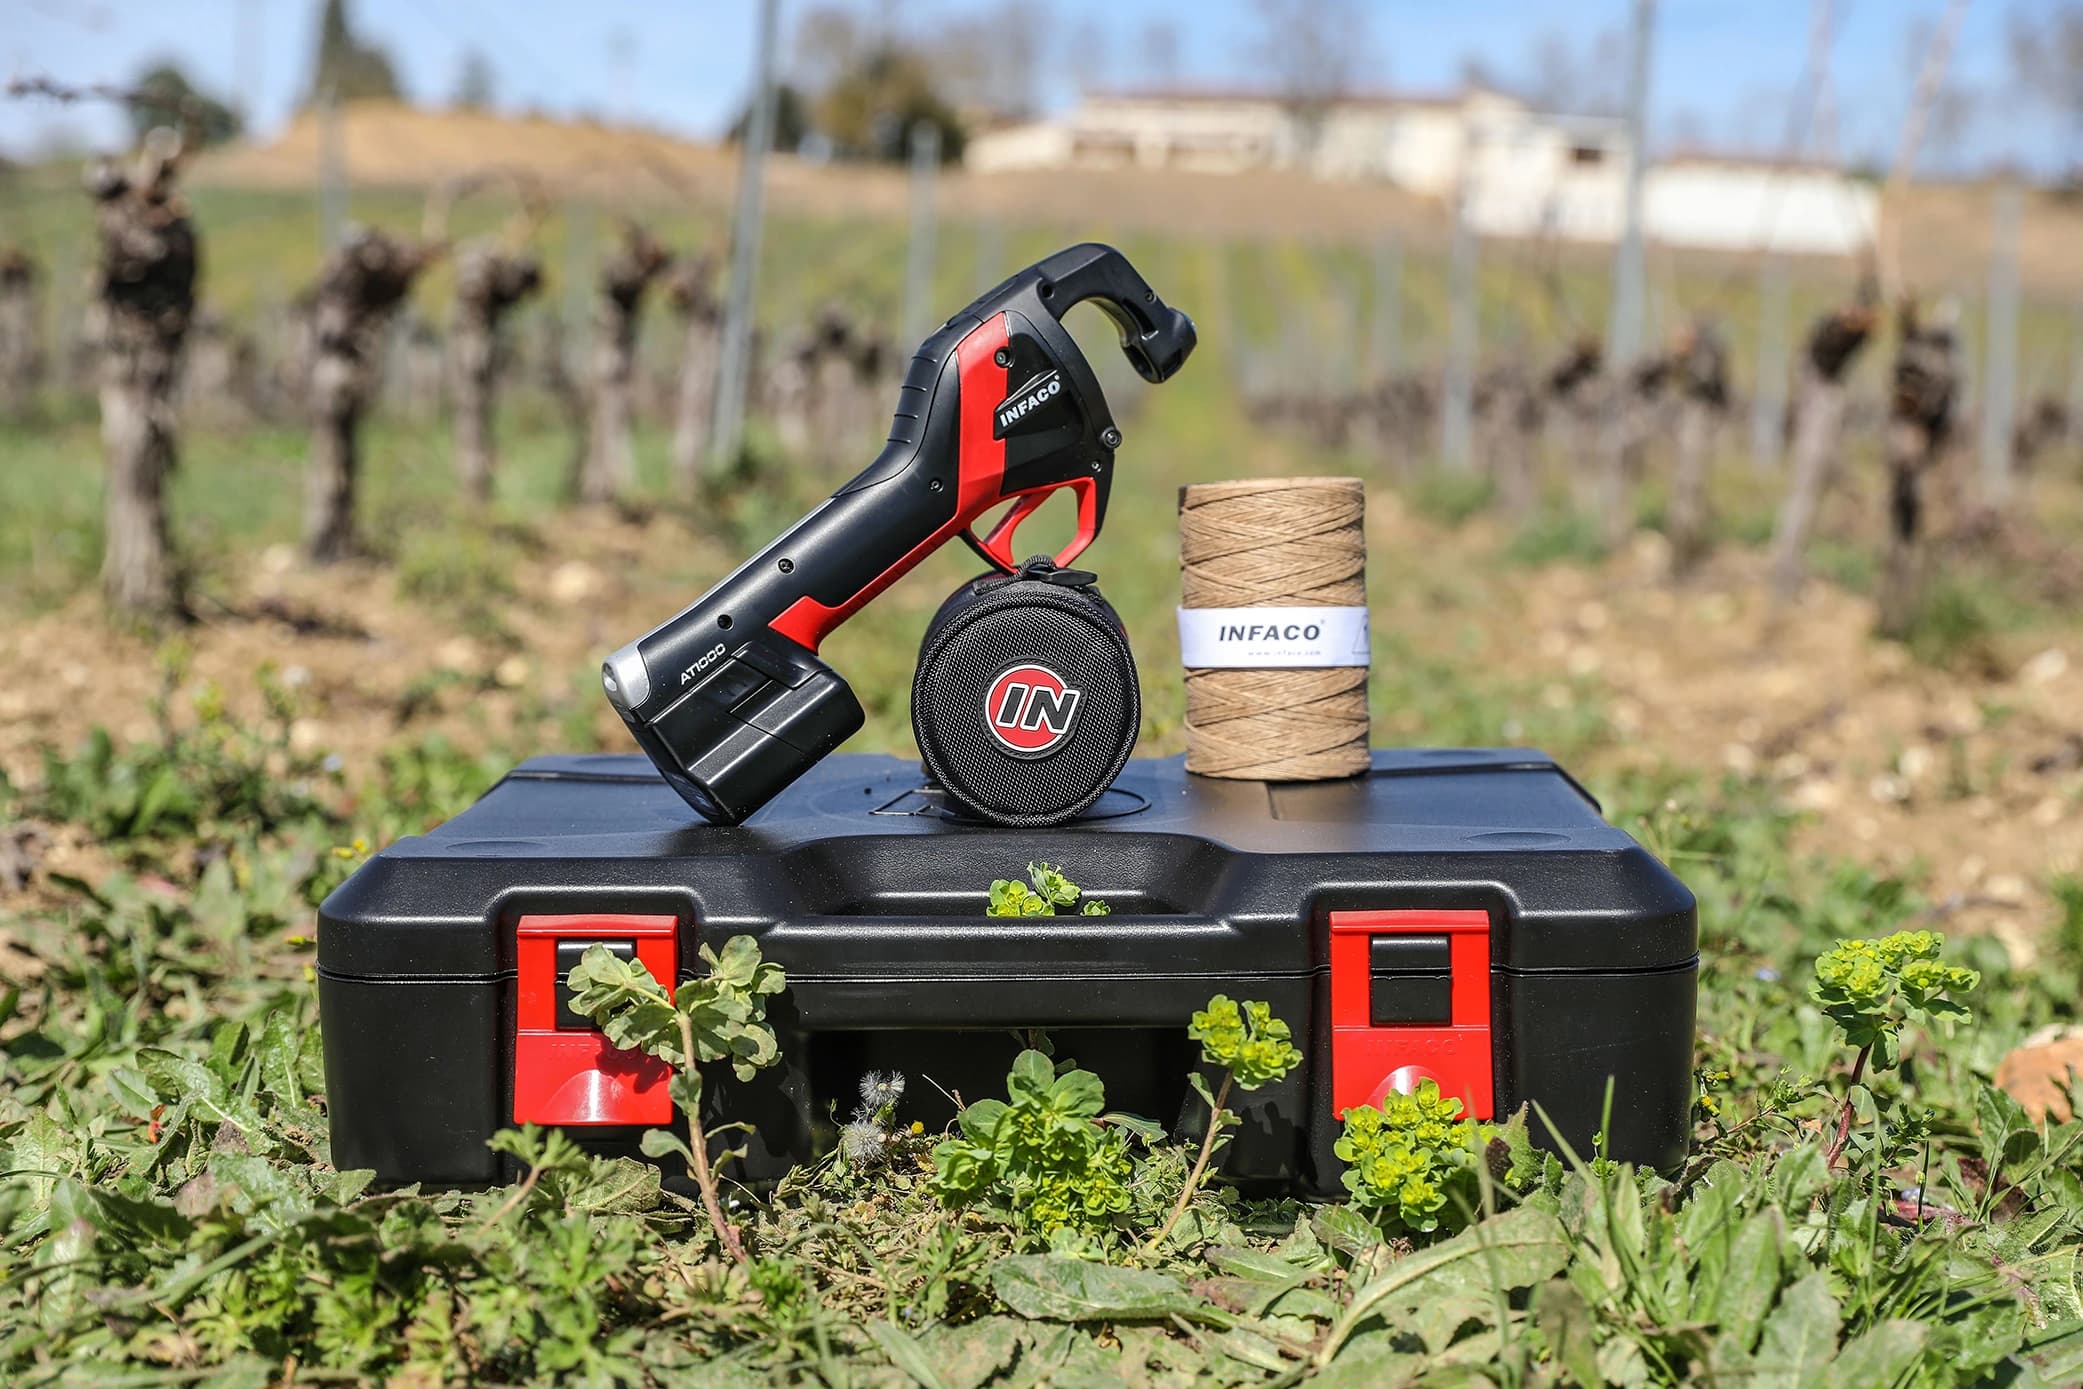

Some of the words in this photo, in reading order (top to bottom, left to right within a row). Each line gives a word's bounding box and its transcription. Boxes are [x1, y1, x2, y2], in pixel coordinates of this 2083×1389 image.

[1000, 381, 1061, 427] INFACO
[1219, 624, 1321, 641] INFACO
[680, 643, 726, 686] AT1000
[995, 682, 1080, 735] IN
